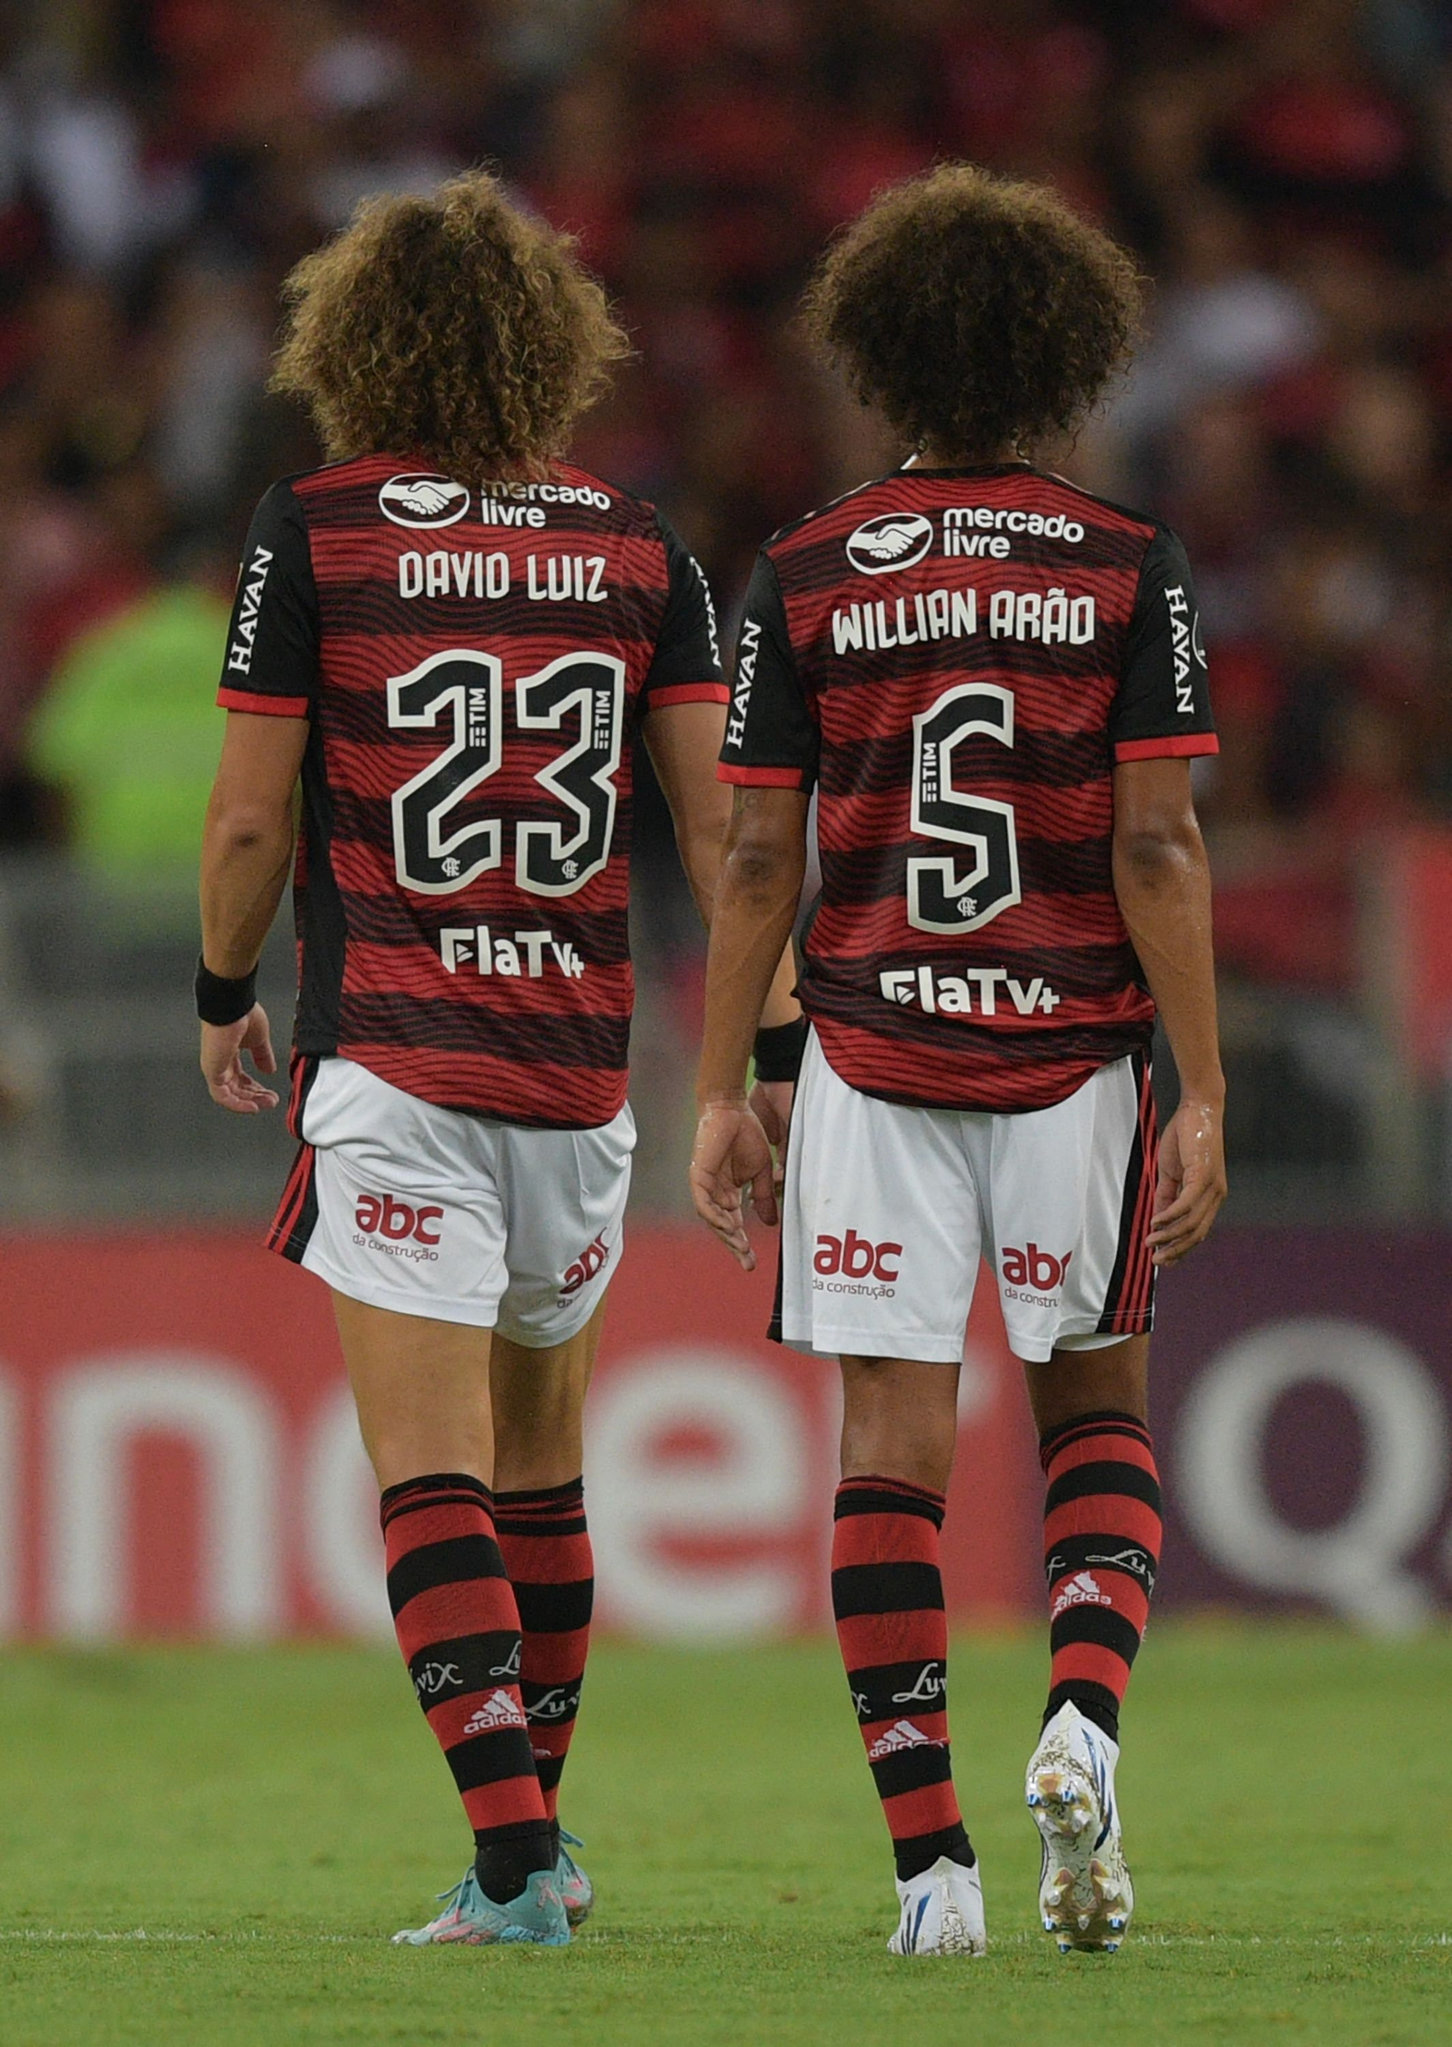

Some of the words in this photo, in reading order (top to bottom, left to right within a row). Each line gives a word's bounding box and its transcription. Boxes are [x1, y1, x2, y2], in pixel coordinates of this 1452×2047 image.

[481, 479, 611, 510] mercado
[481, 499, 546, 528] livre
[943, 508, 1084, 543] mercado
[943, 528, 1010, 559] livre
[399, 551, 509, 600] DAVID
[528, 555, 609, 602] LUIZ
[228, 545, 274, 675] HAVAN
[832, 588, 977, 655] WILLIAN
[990, 588, 1095, 645] ARÃO
[1164, 585, 1195, 714] HAVAN
[726, 618, 762, 749] HAVAN
[387, 648, 626, 897] 23
[907, 682, 1022, 935] 5
[355, 1193, 444, 1245] abc
[352, 1233, 366, 1246] da
[368, 1239, 439, 1263] construção
[813, 1228, 903, 1282] abc
[826, 1281, 895, 1300] construção
[1004, 1287, 1018, 1300] da
